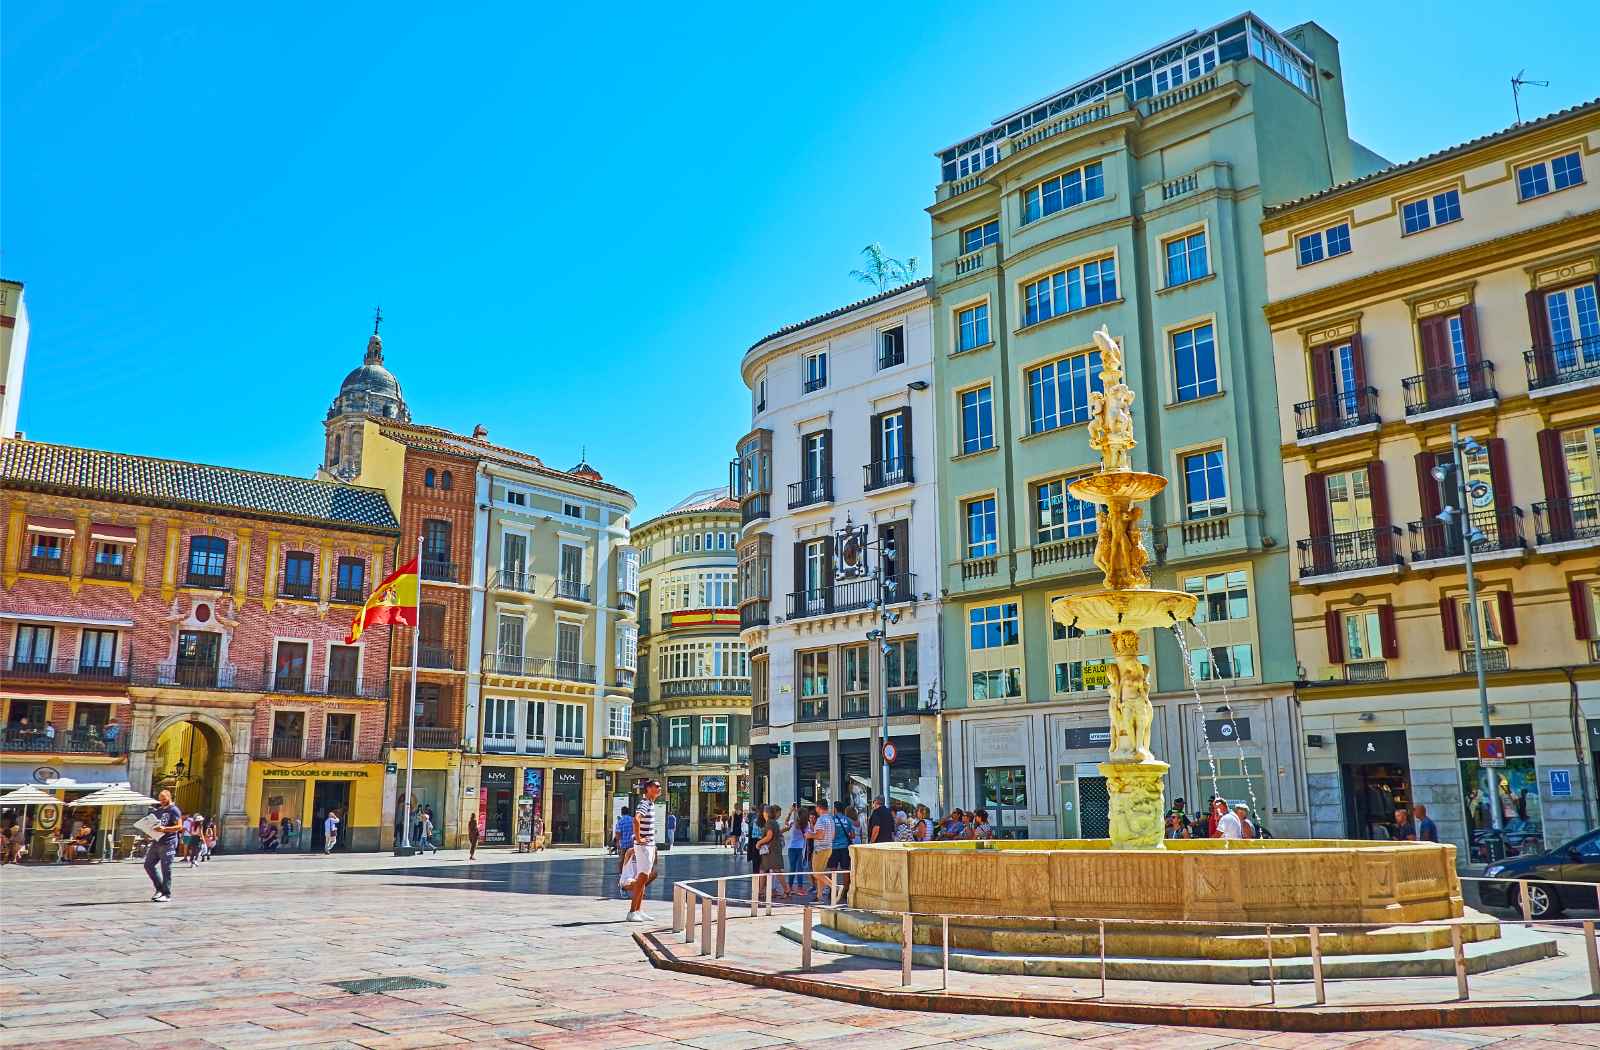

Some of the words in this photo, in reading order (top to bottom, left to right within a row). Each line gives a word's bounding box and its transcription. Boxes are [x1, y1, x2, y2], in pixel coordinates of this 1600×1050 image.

[1457, 735, 1531, 747] SCERS
[291, 769, 320, 777] COLORS
[488, 772, 506, 780] NYX
[1553, 772, 1568, 783] AT
